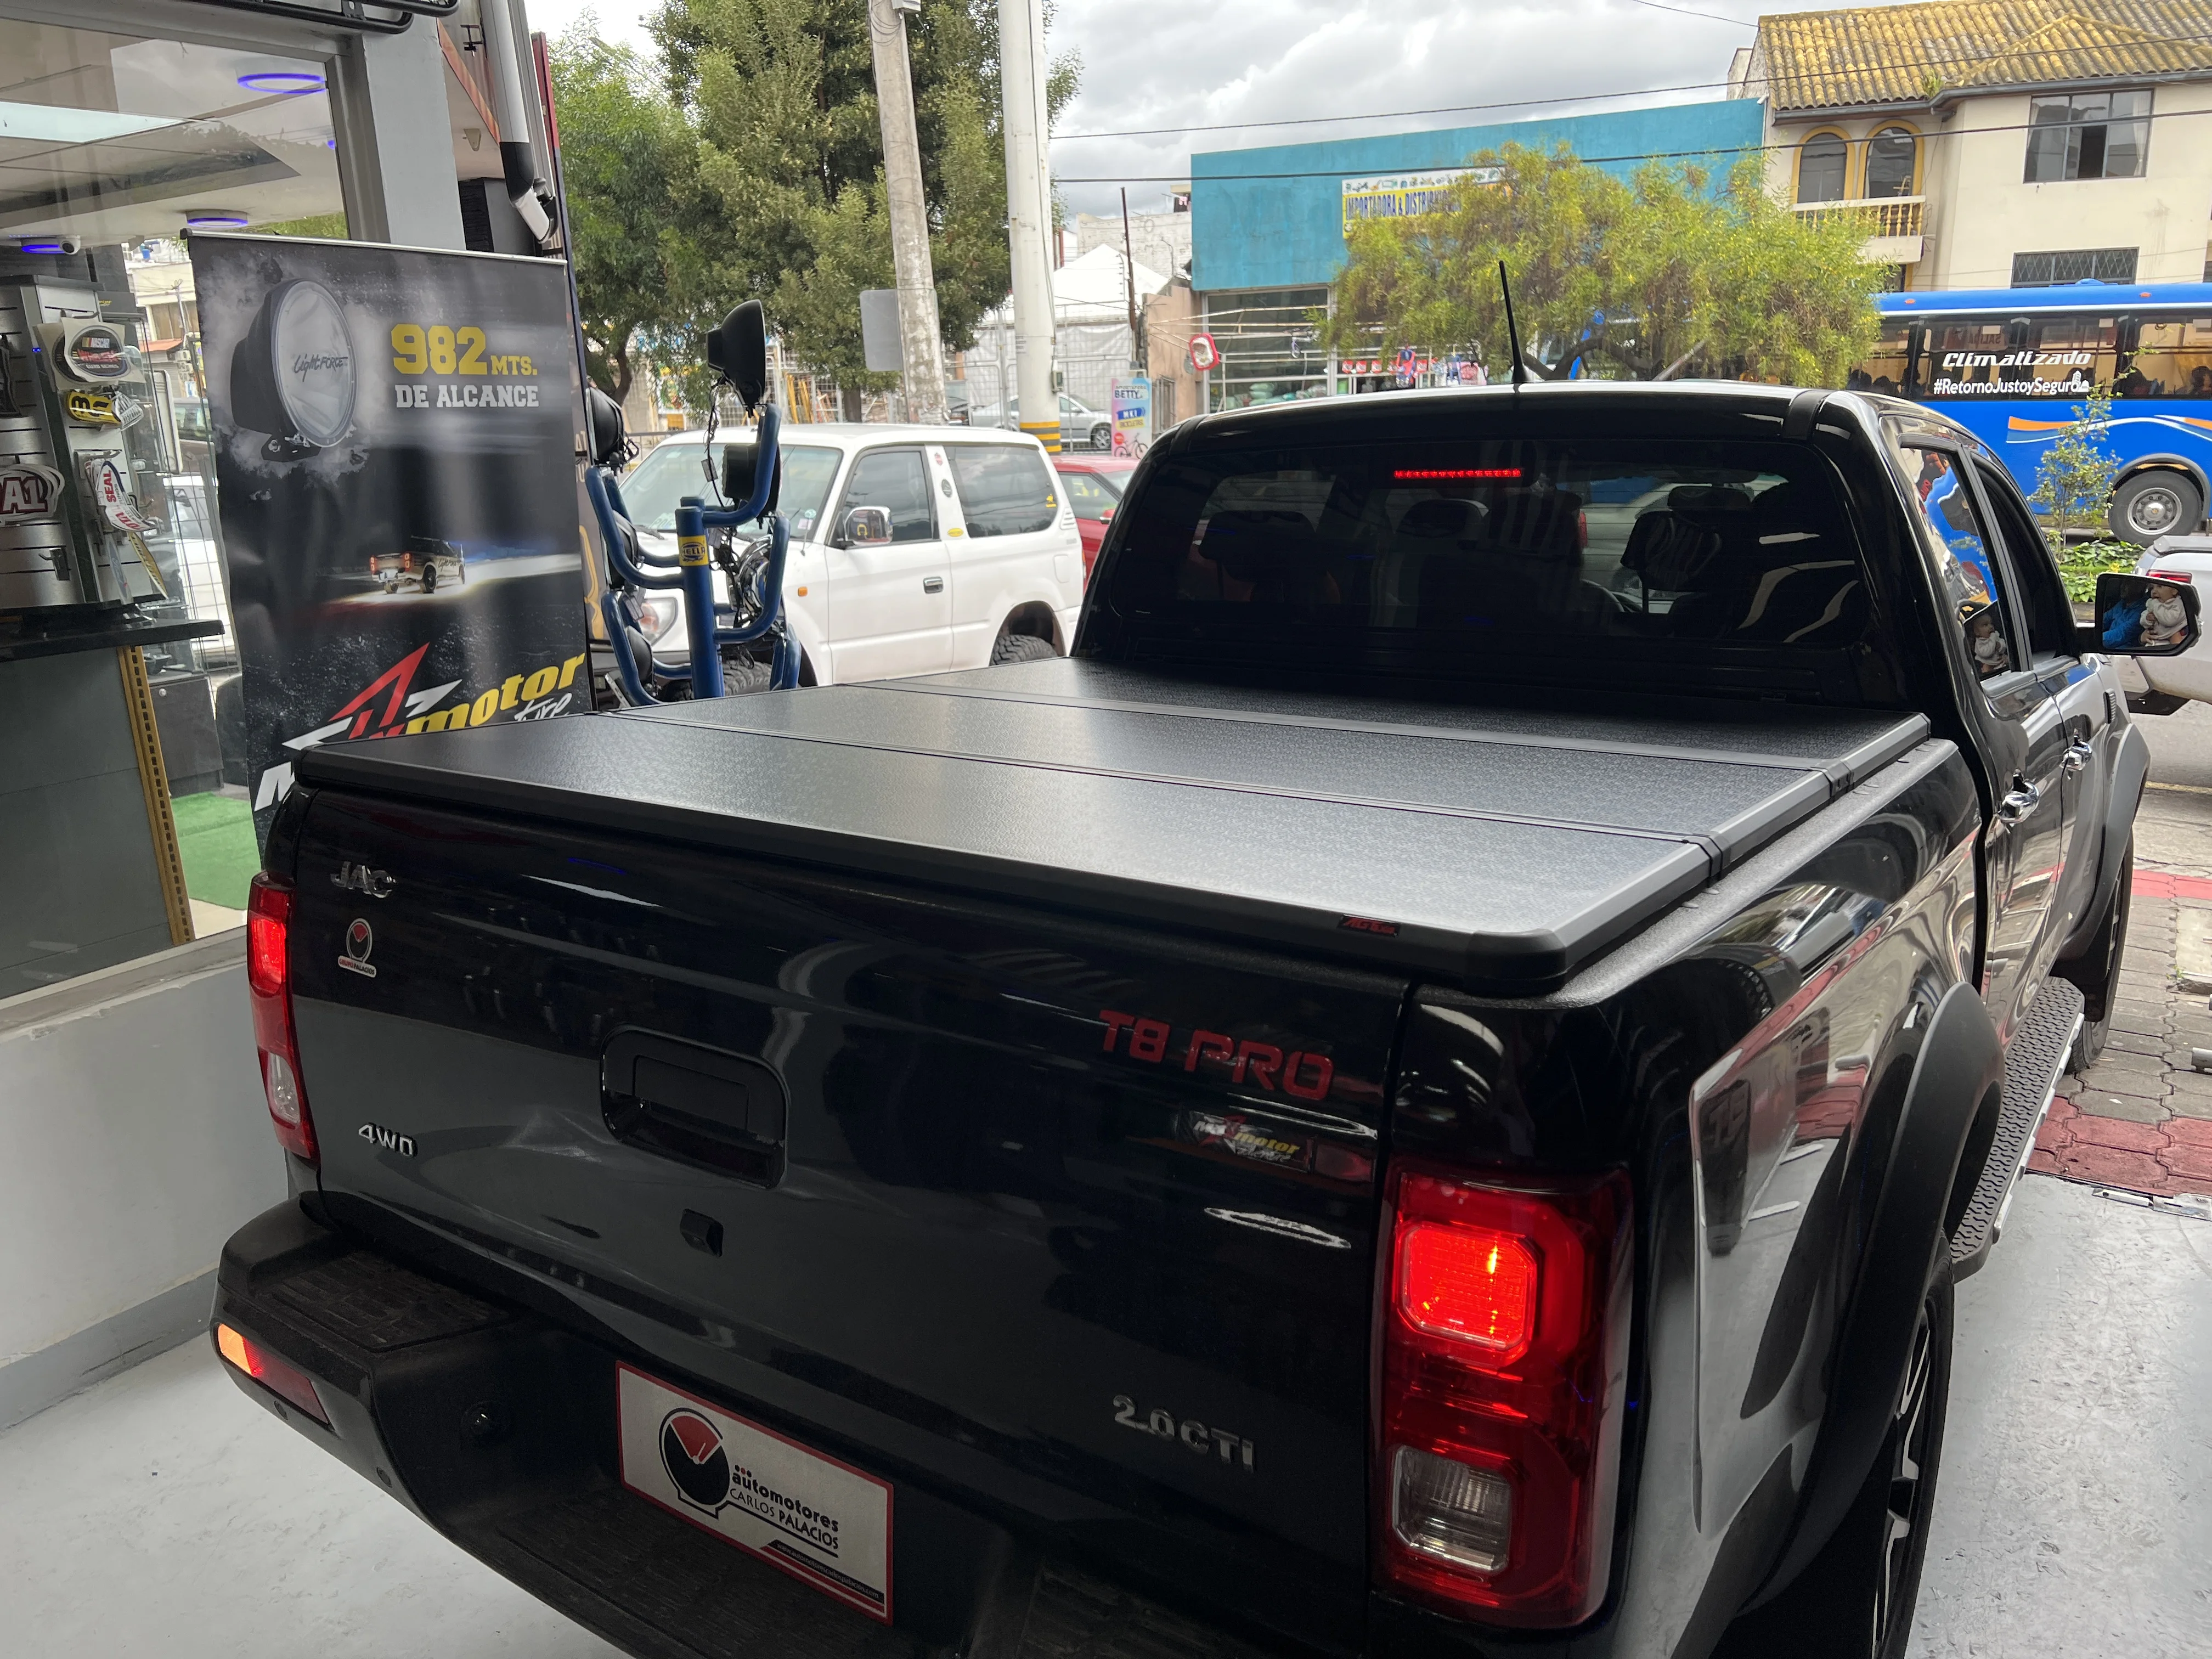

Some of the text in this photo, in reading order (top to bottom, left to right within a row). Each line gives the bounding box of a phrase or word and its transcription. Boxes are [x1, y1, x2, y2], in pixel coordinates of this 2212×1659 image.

[391, 324, 538, 376] 982 MTS.
[395, 385, 539, 408] DE ALCANCE
[1933, 377, 2079, 396] #RetornoJustoySeguro
[0, 476, 48, 514] A1
[103, 470, 117, 503] SEAL
[405, 652, 585, 735] motor
[330, 861, 397, 899] JAC
[354, 963, 375, 975] PALACIOS
[1099, 1009, 1334, 1101] T8 PRO
[358, 1122, 418, 1158] 4WD
[730, 1488, 839, 1549] CARLOS PALACIOS
